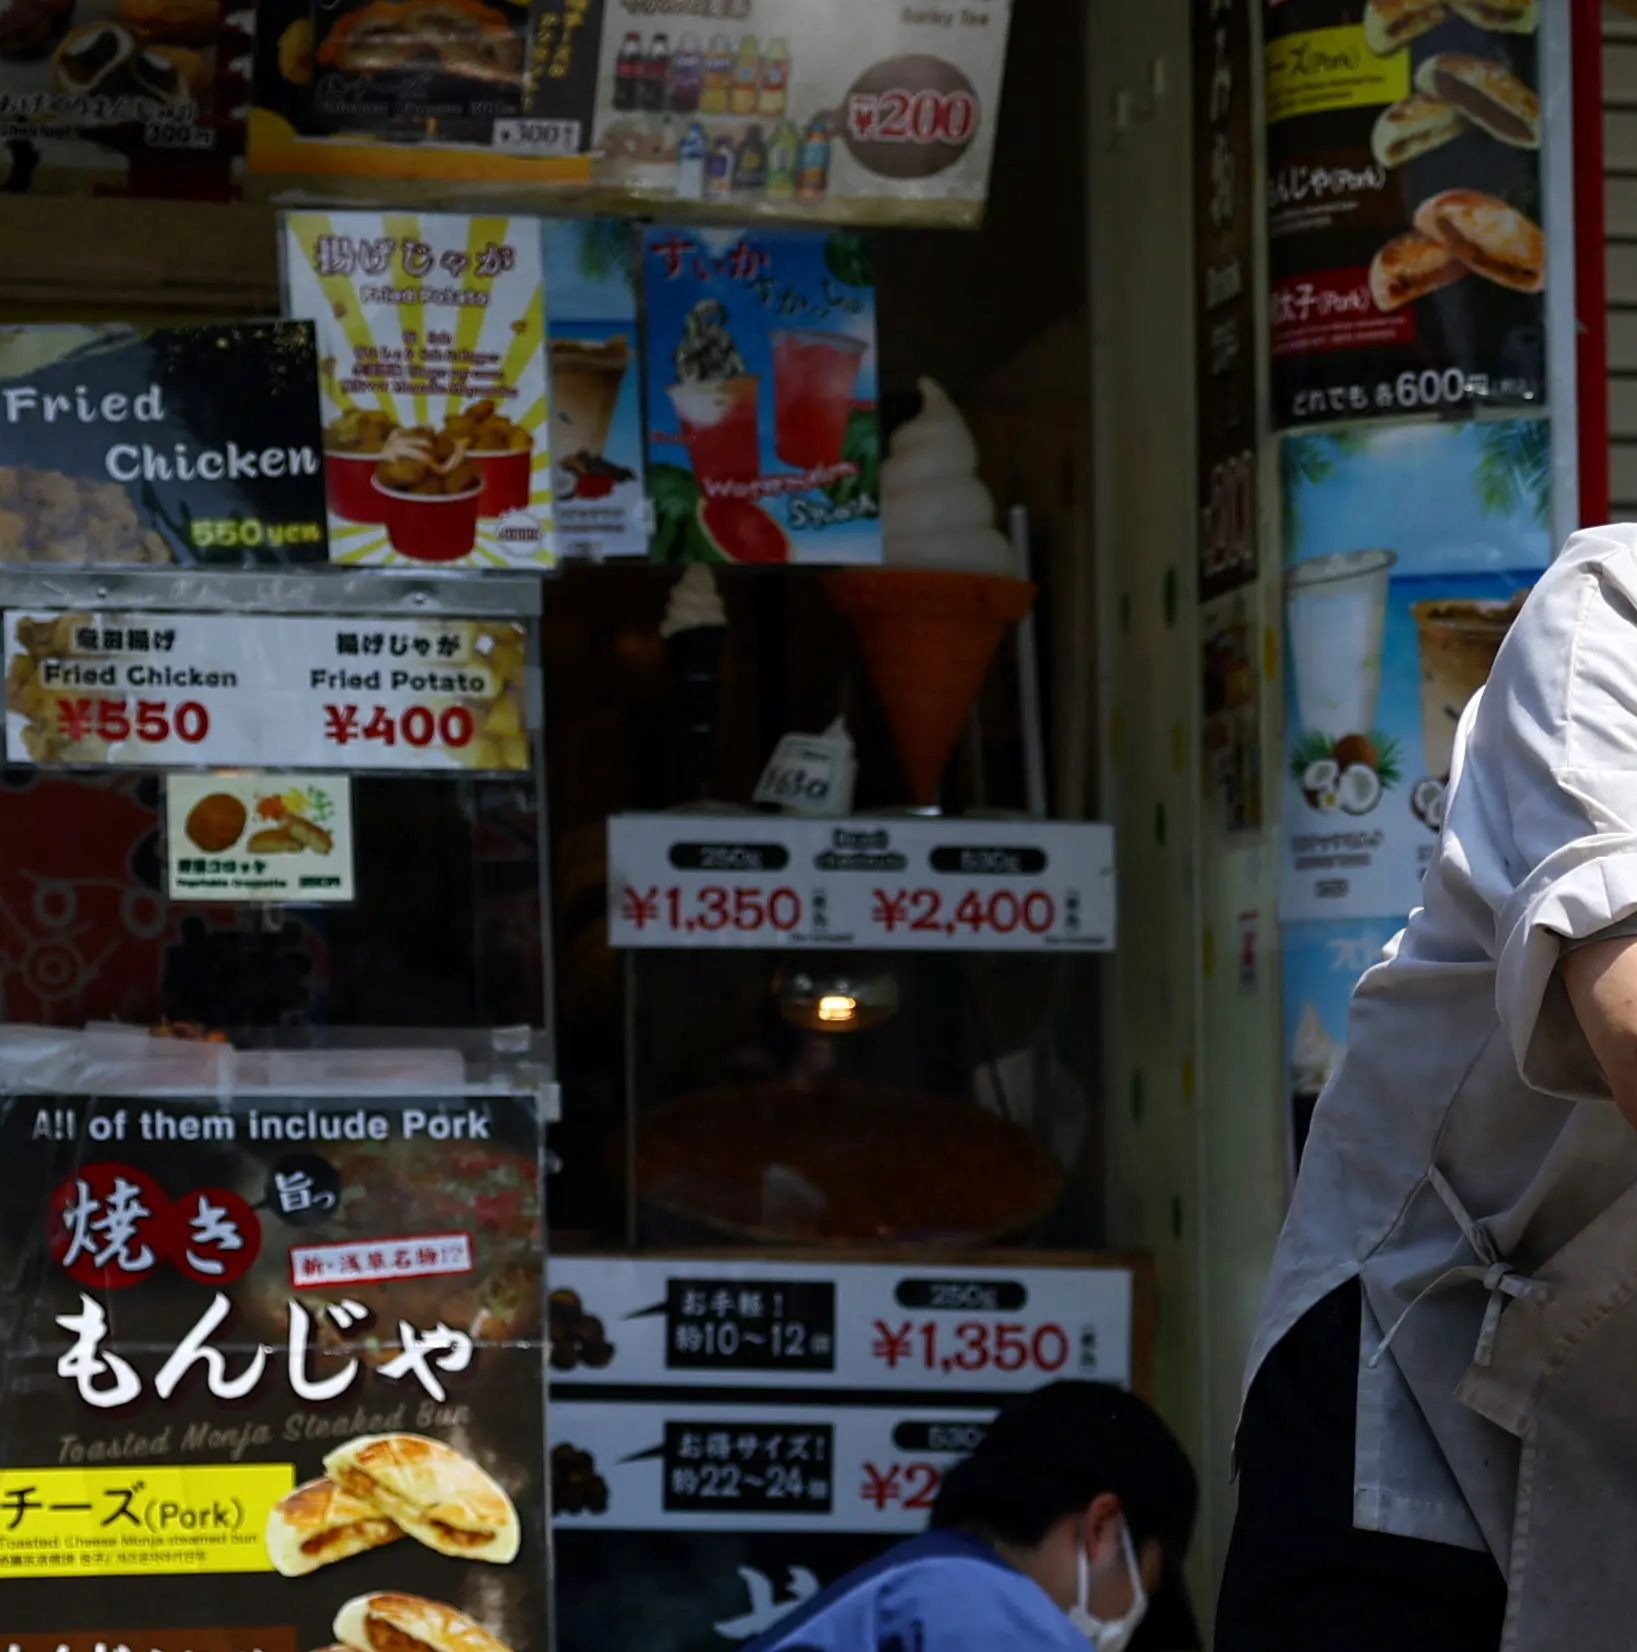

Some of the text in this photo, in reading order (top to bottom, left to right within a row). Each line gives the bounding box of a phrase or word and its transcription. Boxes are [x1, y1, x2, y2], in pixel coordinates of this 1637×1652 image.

[848, 90, 973, 142] ¥200
[315, 236, 513, 277] 揚げじゃが
[652, 238, 770, 281] すいか
[1, 383, 167, 424] Fried
[1291, 383, 1371, 417] どれでも
[105, 439, 321, 482] Chicken
[336, 633, 460, 656] 揚げじゃが
[44, 665, 238, 687] Fried Chicken
[311, 669, 485, 692] Fried Potato
[57, 699, 209, 742] ¥550
[325, 704, 474, 747] ¥400
[623, 886, 803, 932] ¥1,350
[872, 888, 1055, 938] ¥2,400
[32, 1107, 492, 1142] All of them include Pork
[62, 1177, 245, 1275] 焼き
[55, 1292, 474, 1408] もんじゃ
[872, 1319, 1069, 1373] ¥1,350
[58, 1421, 174, 1463] Toasted
[180, 1419, 275, 1462] Monja
[415, 1399, 473, 1429] Bun
[1, 1480, 246, 1534] チーズ(Pork)
